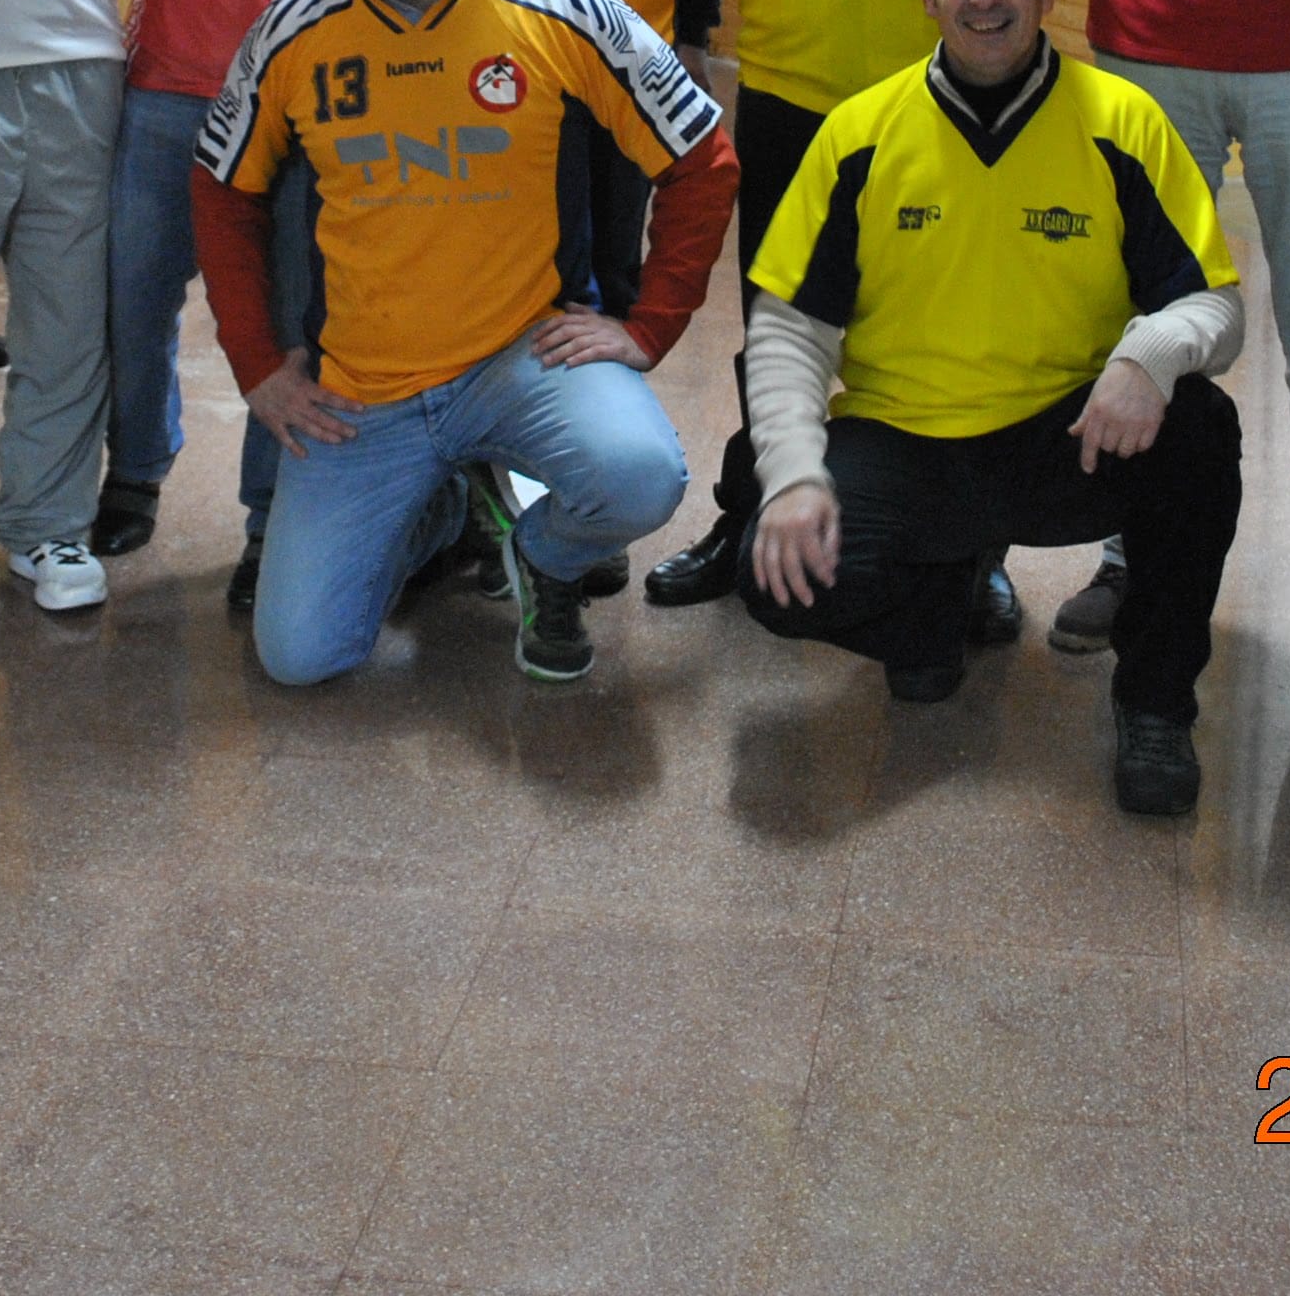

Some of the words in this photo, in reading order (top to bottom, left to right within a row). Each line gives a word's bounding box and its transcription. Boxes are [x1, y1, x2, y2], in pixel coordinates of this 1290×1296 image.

[314, 56, 368, 123] 13
[386, 59, 444, 77] luanvi
[334, 126, 512, 185] TNP
